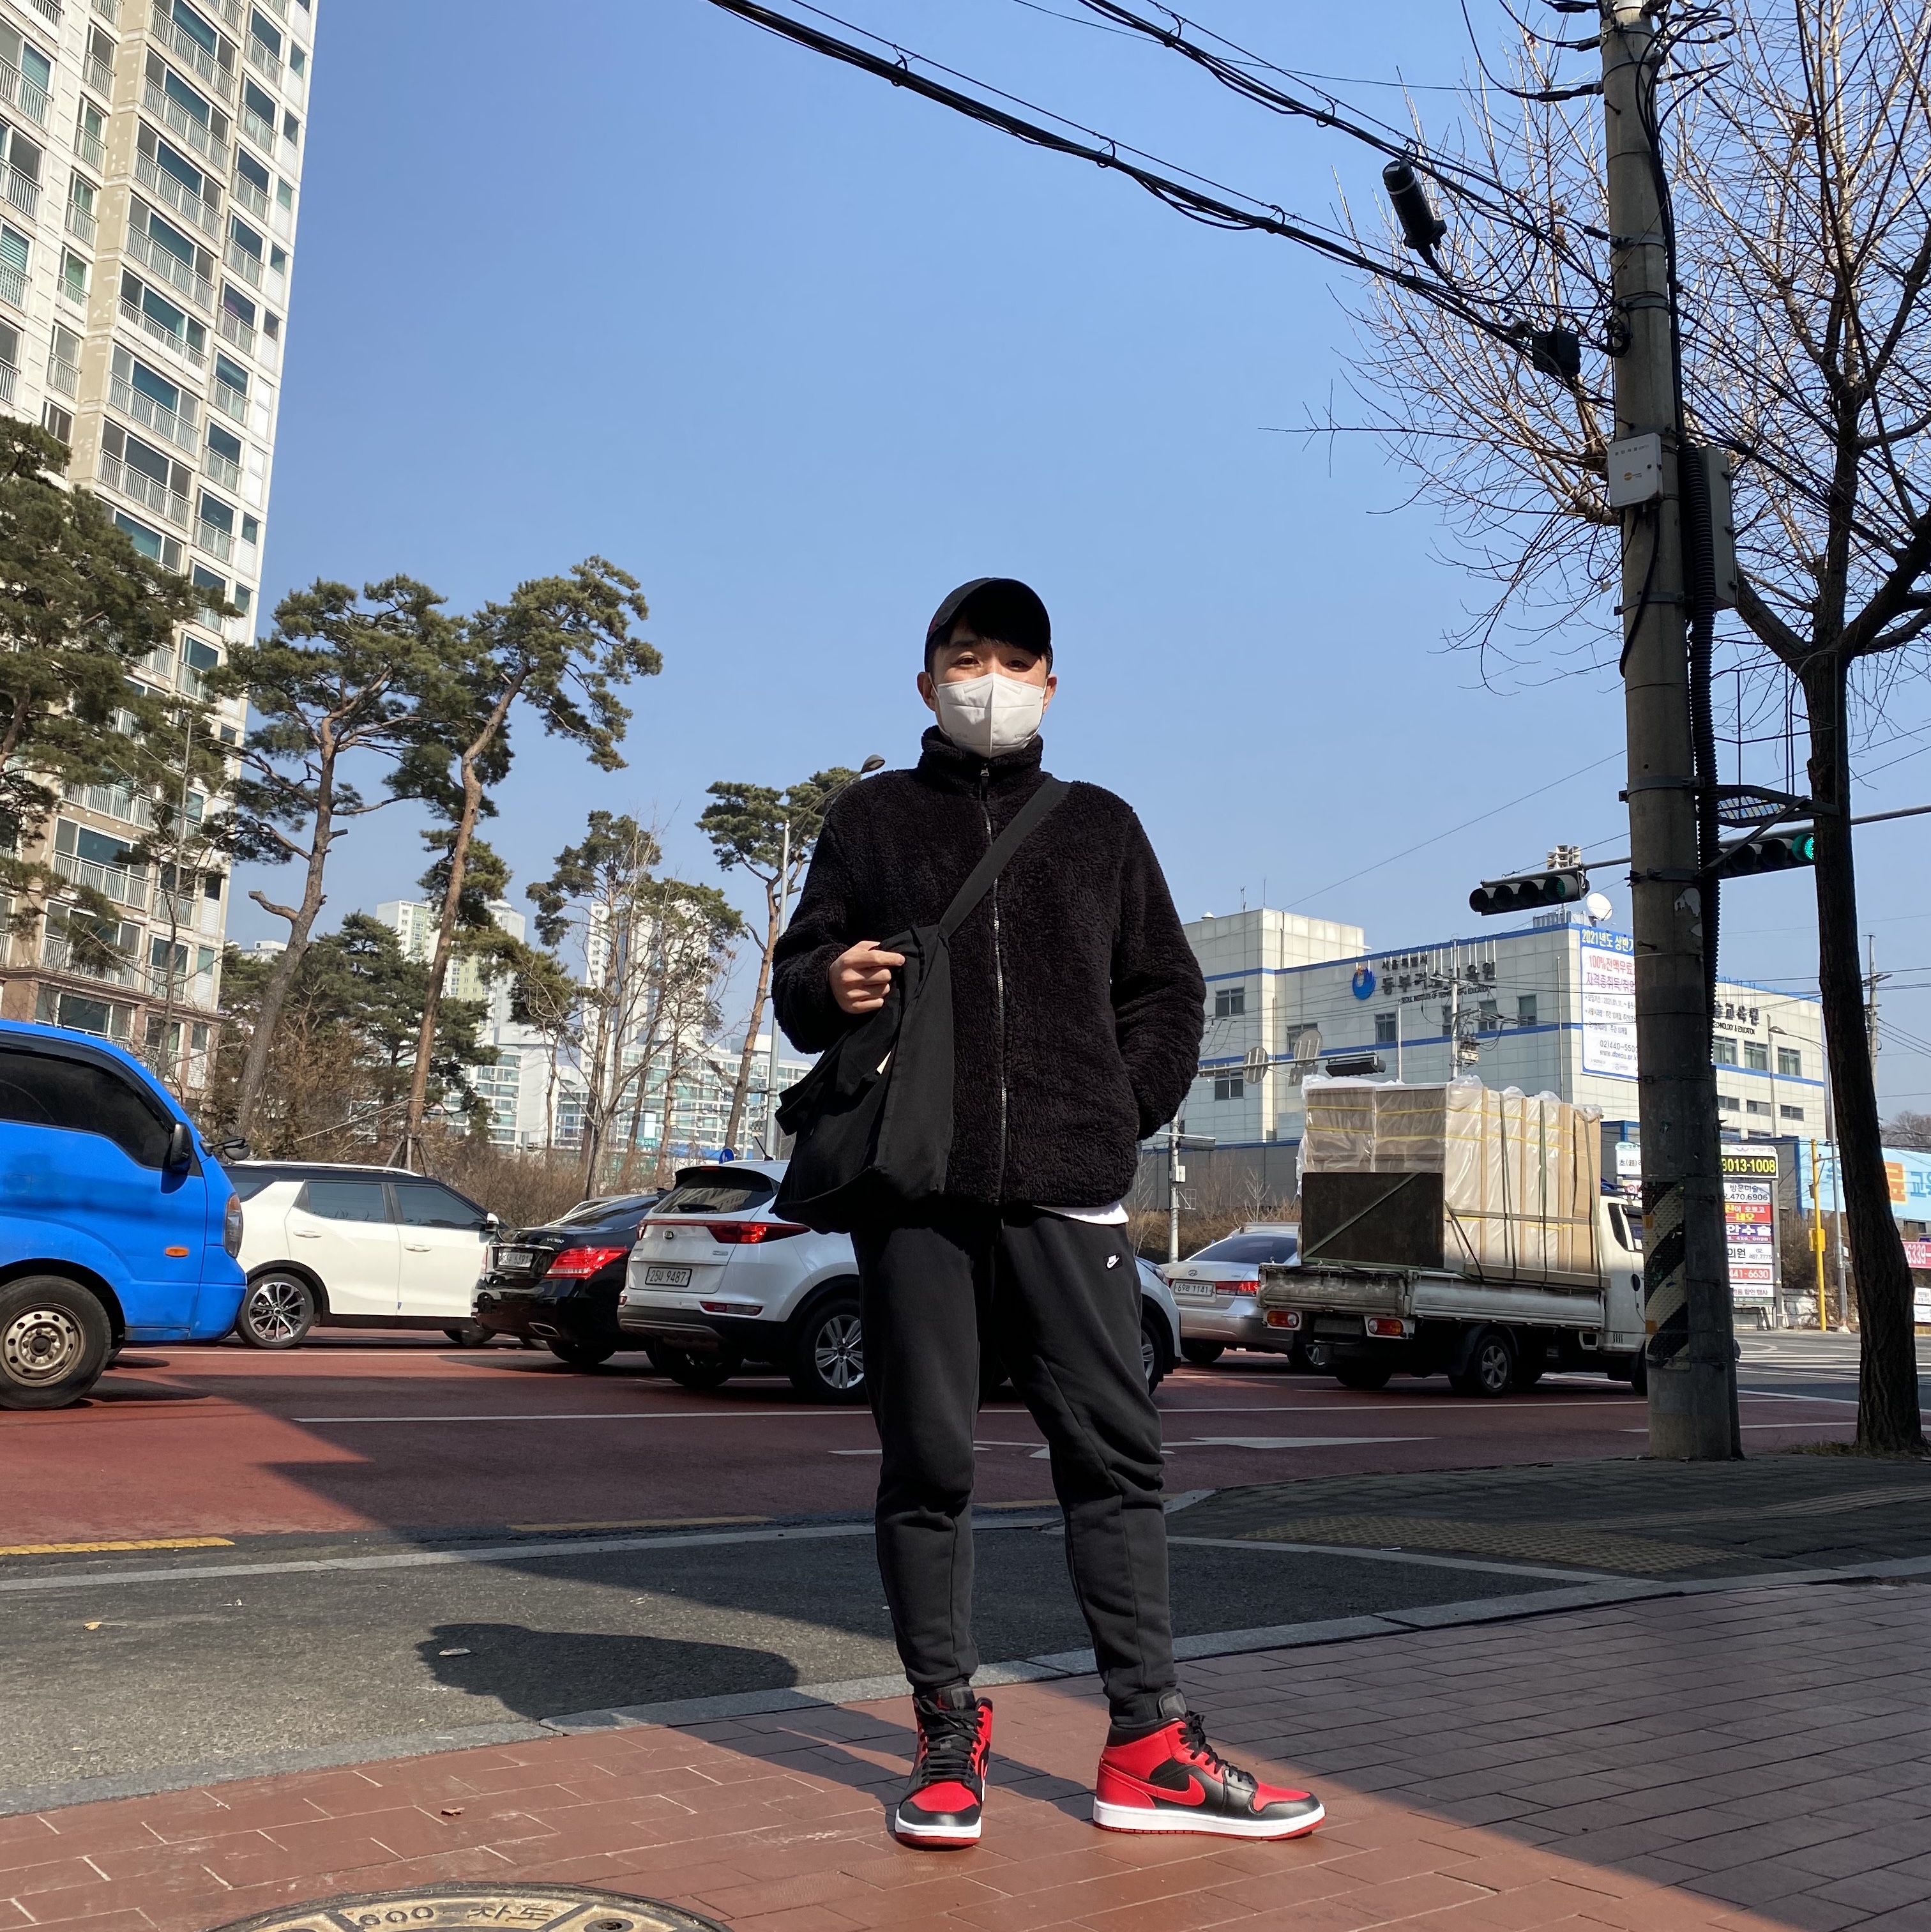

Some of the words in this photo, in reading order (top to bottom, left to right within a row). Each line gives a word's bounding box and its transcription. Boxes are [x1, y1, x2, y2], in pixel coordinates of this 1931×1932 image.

[1582, 929, 1614, 948] 2021년도
[1589, 955, 1635, 975] 100%전액무료
[1738, 1025, 1755, 1035] EDUCATION
[1721, 1158, 1776, 1173] 3013-1008
[1730, 1184, 1759, 1193] 방문미술
[1910, 1171, 1931, 1198] 교
[1728, 1247, 1746, 1259] 의원
[667, 1270, 686, 1284] 9487
[1729, 1269, 1769, 1279] 441-6630
[1193, 1285, 1208, 1294] 1141
